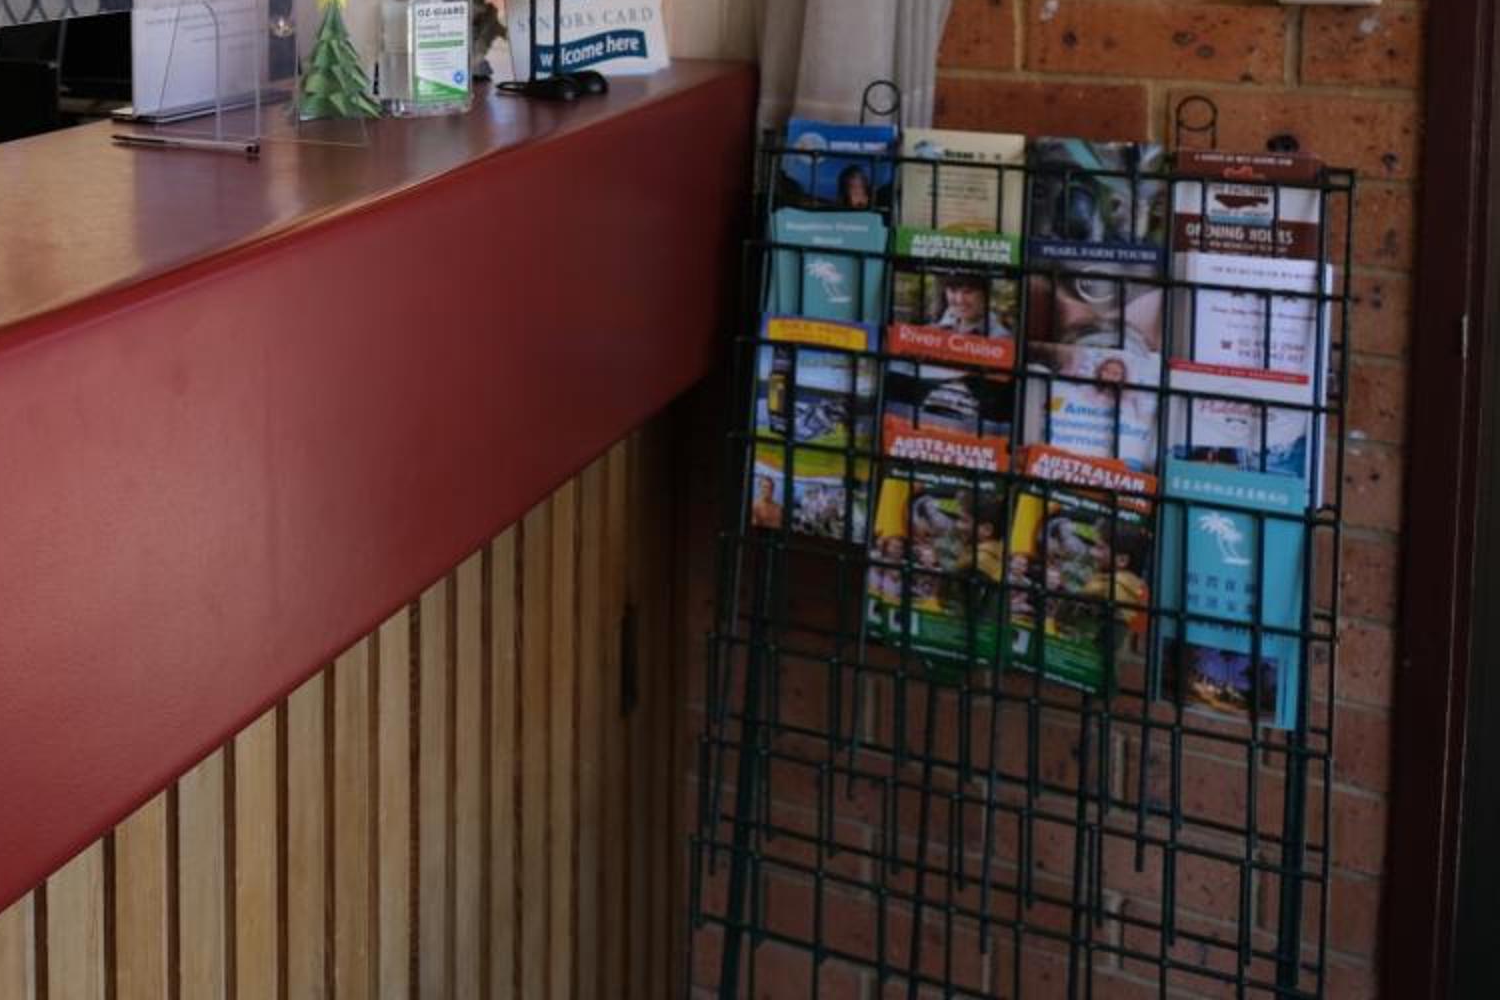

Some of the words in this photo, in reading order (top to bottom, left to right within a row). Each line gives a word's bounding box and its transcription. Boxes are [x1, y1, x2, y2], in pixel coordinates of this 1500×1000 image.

[517, 11, 596, 32] SNORS
[603, 6, 653, 23] CARD
[540, 37, 604, 67] wlcome
[605, 33, 640, 56] here
[911, 233, 1012, 252] AUSTRALIAN
[1185, 222, 1244, 241] OPNING
[899, 323, 942, 347] River
[948, 334, 1005, 357] Cruise
[894, 436, 995, 459] AUSTRALIAN
[1037, 453, 1146, 493] AUSTRALIAN
